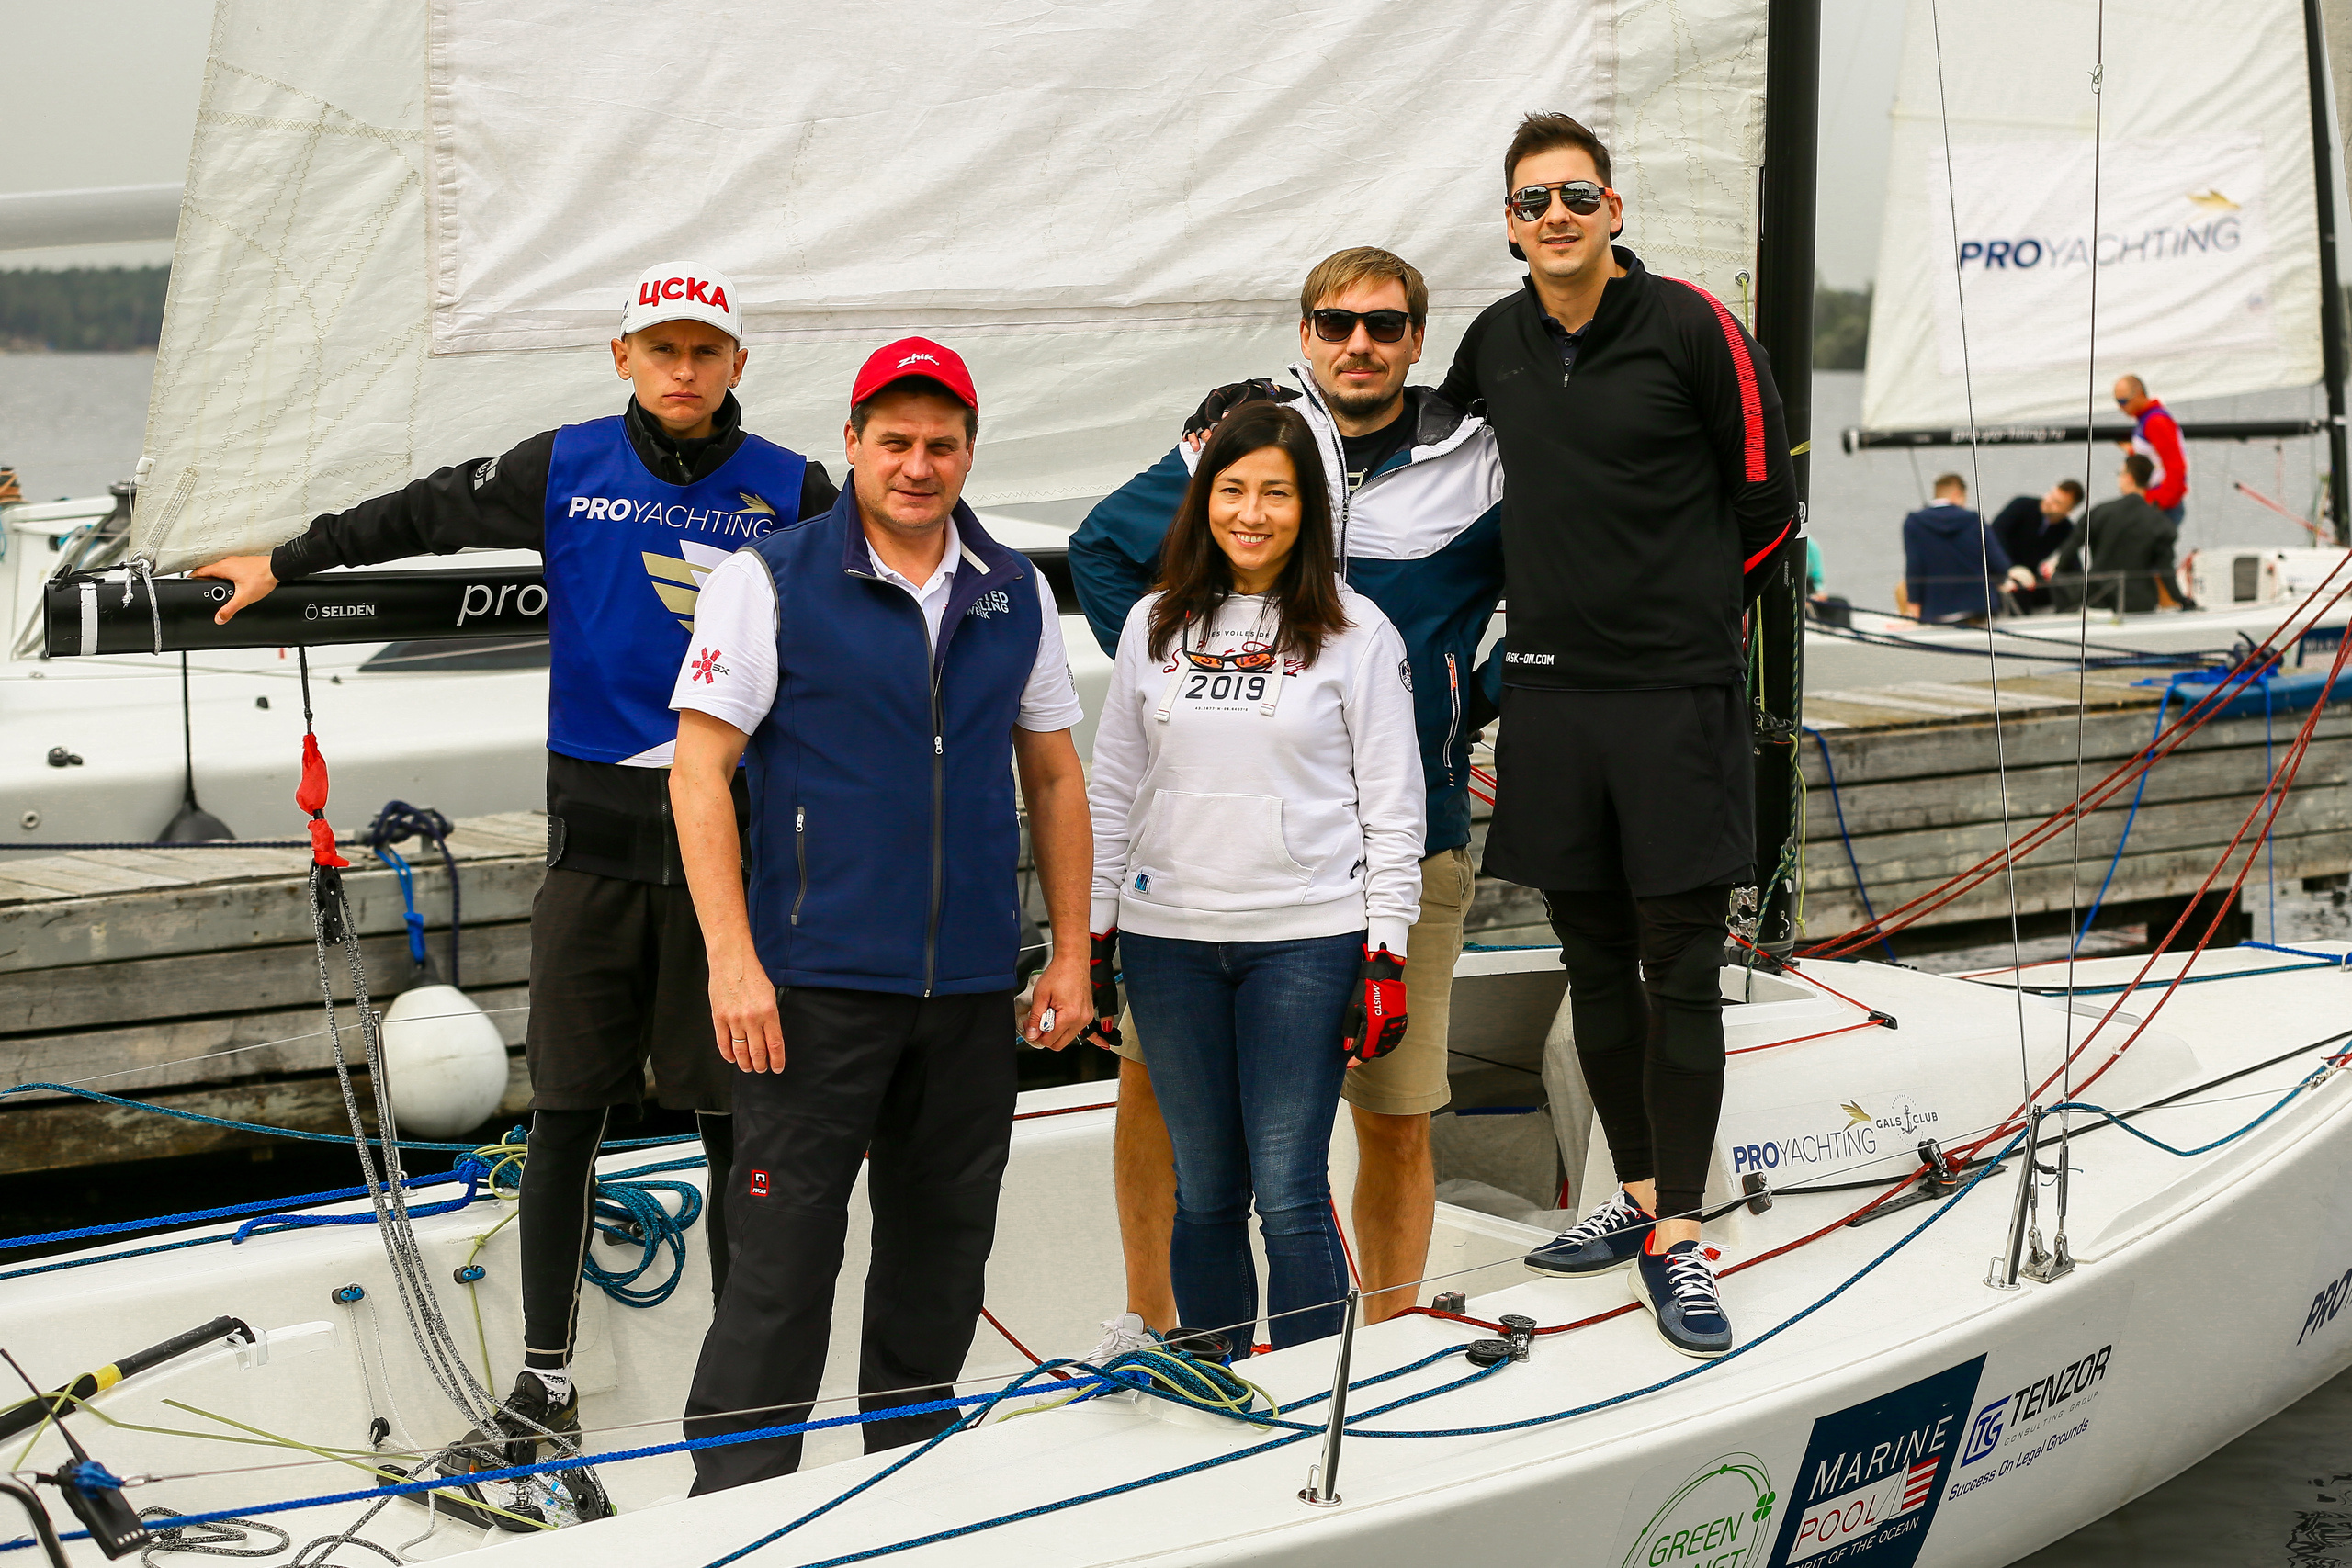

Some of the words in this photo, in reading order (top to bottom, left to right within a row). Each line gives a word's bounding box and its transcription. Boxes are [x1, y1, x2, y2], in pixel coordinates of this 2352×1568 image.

[1959, 216, 2242, 270] PROYACHTING
[639, 276, 730, 314] ЦСКА
[568, 496, 774, 538] PROYACHTING
[322, 603, 375, 617] SELDÉN
[1185, 675, 1266, 701] 2019
[1372, 983, 1383, 1016] MUSTO
[1876, 1117, 1902, 1129] GALS
[1912, 1111, 1939, 1123] CLUB
[1733, 1127, 1876, 1173] PROYACHTING
[2010, 1344, 2112, 1427] TENZOR
[2004, 1409, 2064, 1446] CONSULTING
[2069, 1390, 2099, 1412] GROUP
[1807, 1414, 1954, 1502] MARINE
[1948, 1469, 1996, 1502] Success
[1997, 1459, 2014, 1477] On
[2016, 1439, 2047, 1468] Legal
[2046, 1417, 2090, 1451] Grounds
[1648, 1512, 1745, 1567] GREEN
[1793, 1494, 1878, 1552] POOL
[1827, 1547, 1848, 1564] OF
[1850, 1535, 1876, 1556] THE
[1878, 1516, 1920, 1544] OCEAN
